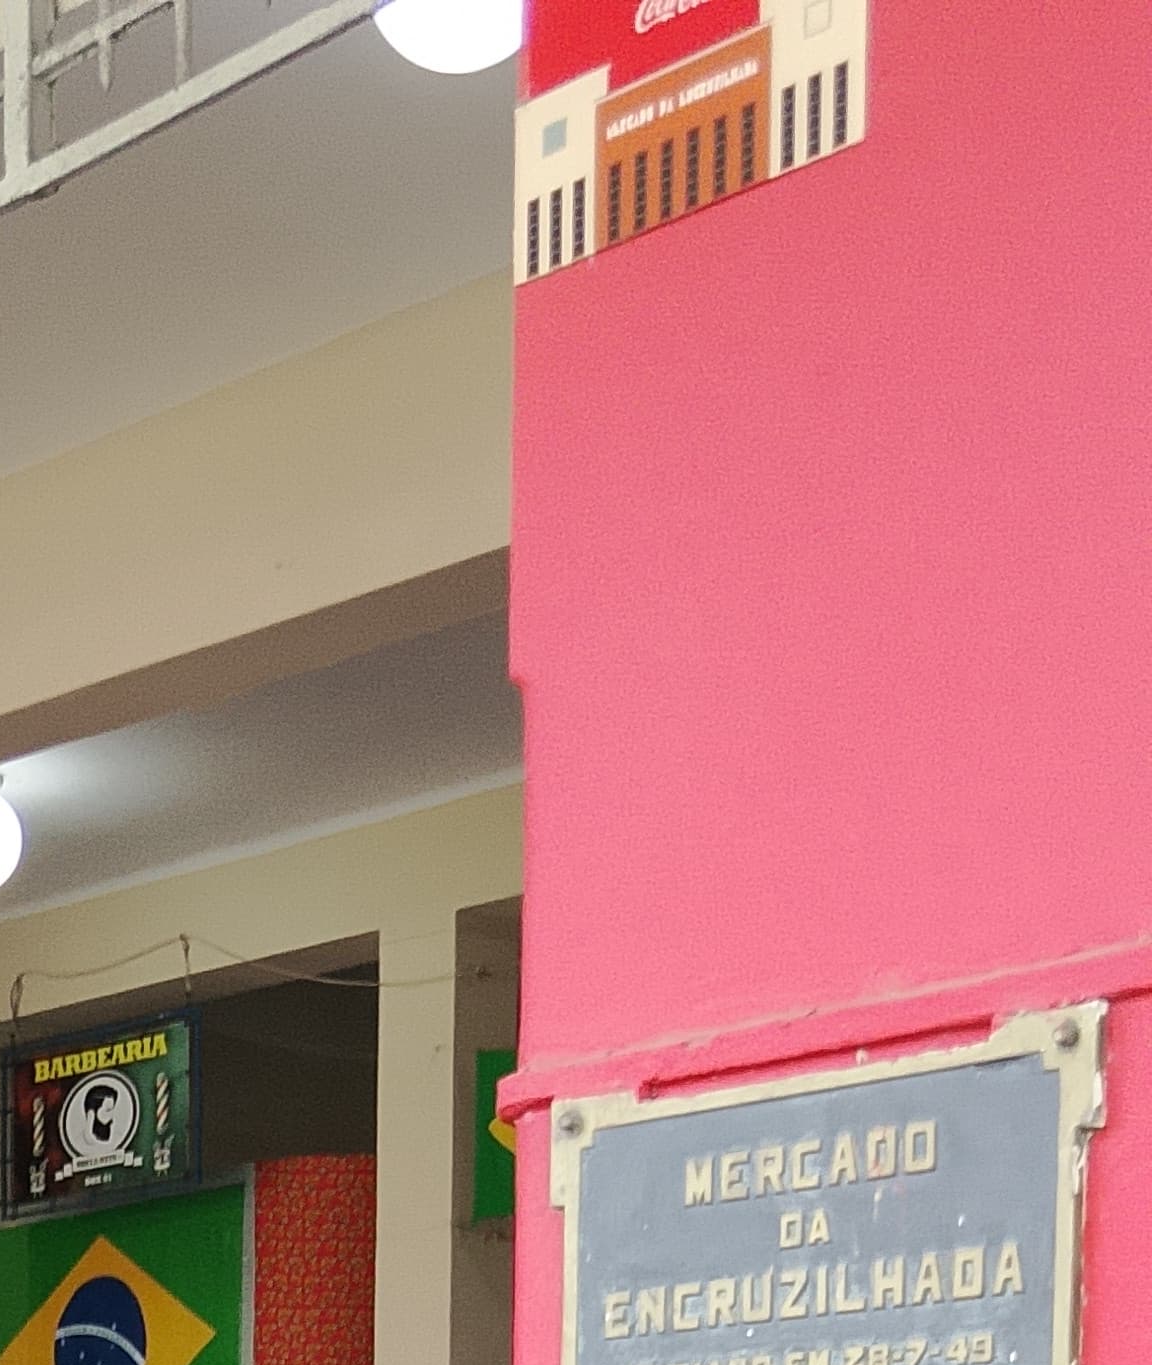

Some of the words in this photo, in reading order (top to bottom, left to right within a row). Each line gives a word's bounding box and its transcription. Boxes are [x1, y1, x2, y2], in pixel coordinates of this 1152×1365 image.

[34, 1032, 168, 1084] BARBEARIA
[684, 1118, 939, 1207] MERCADO
[778, 1207, 831, 1250] DA
[604, 1241, 1025, 1340] ENCRUZILHADA
